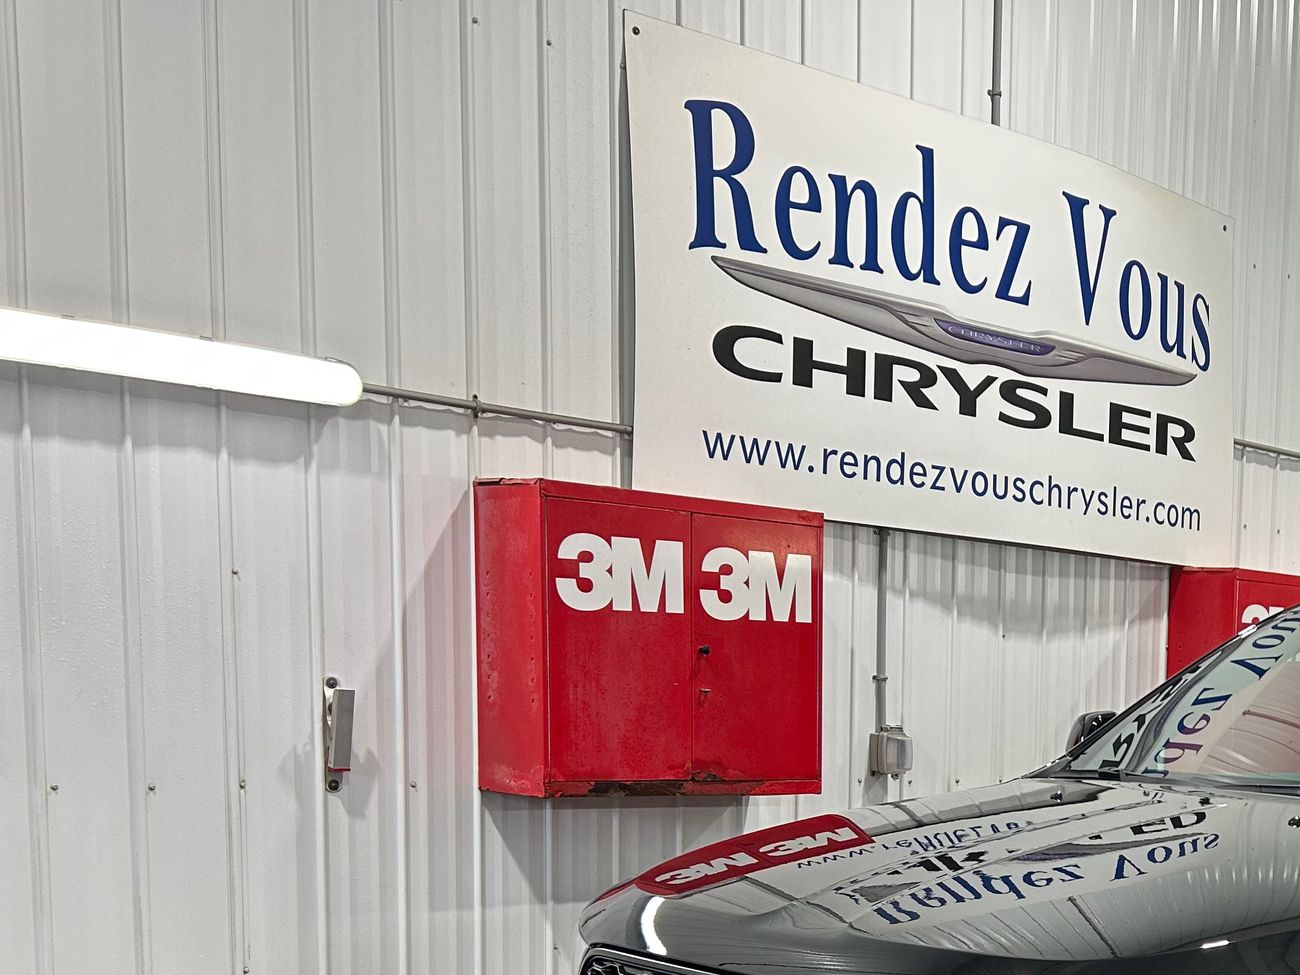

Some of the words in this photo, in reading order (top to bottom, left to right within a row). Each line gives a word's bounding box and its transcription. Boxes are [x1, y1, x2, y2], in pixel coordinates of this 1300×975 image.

[684, 99, 1032, 306] Rendez
[1062, 191, 1210, 373] Vous
[948, 326, 1041, 354] CHRYSLER
[712, 325, 1196, 462] CHRYSLER
[703, 429, 1201, 531] www.rendezvouschrysler.com
[555, 532, 684, 614] 3M
[699, 546, 812, 624] 3M
